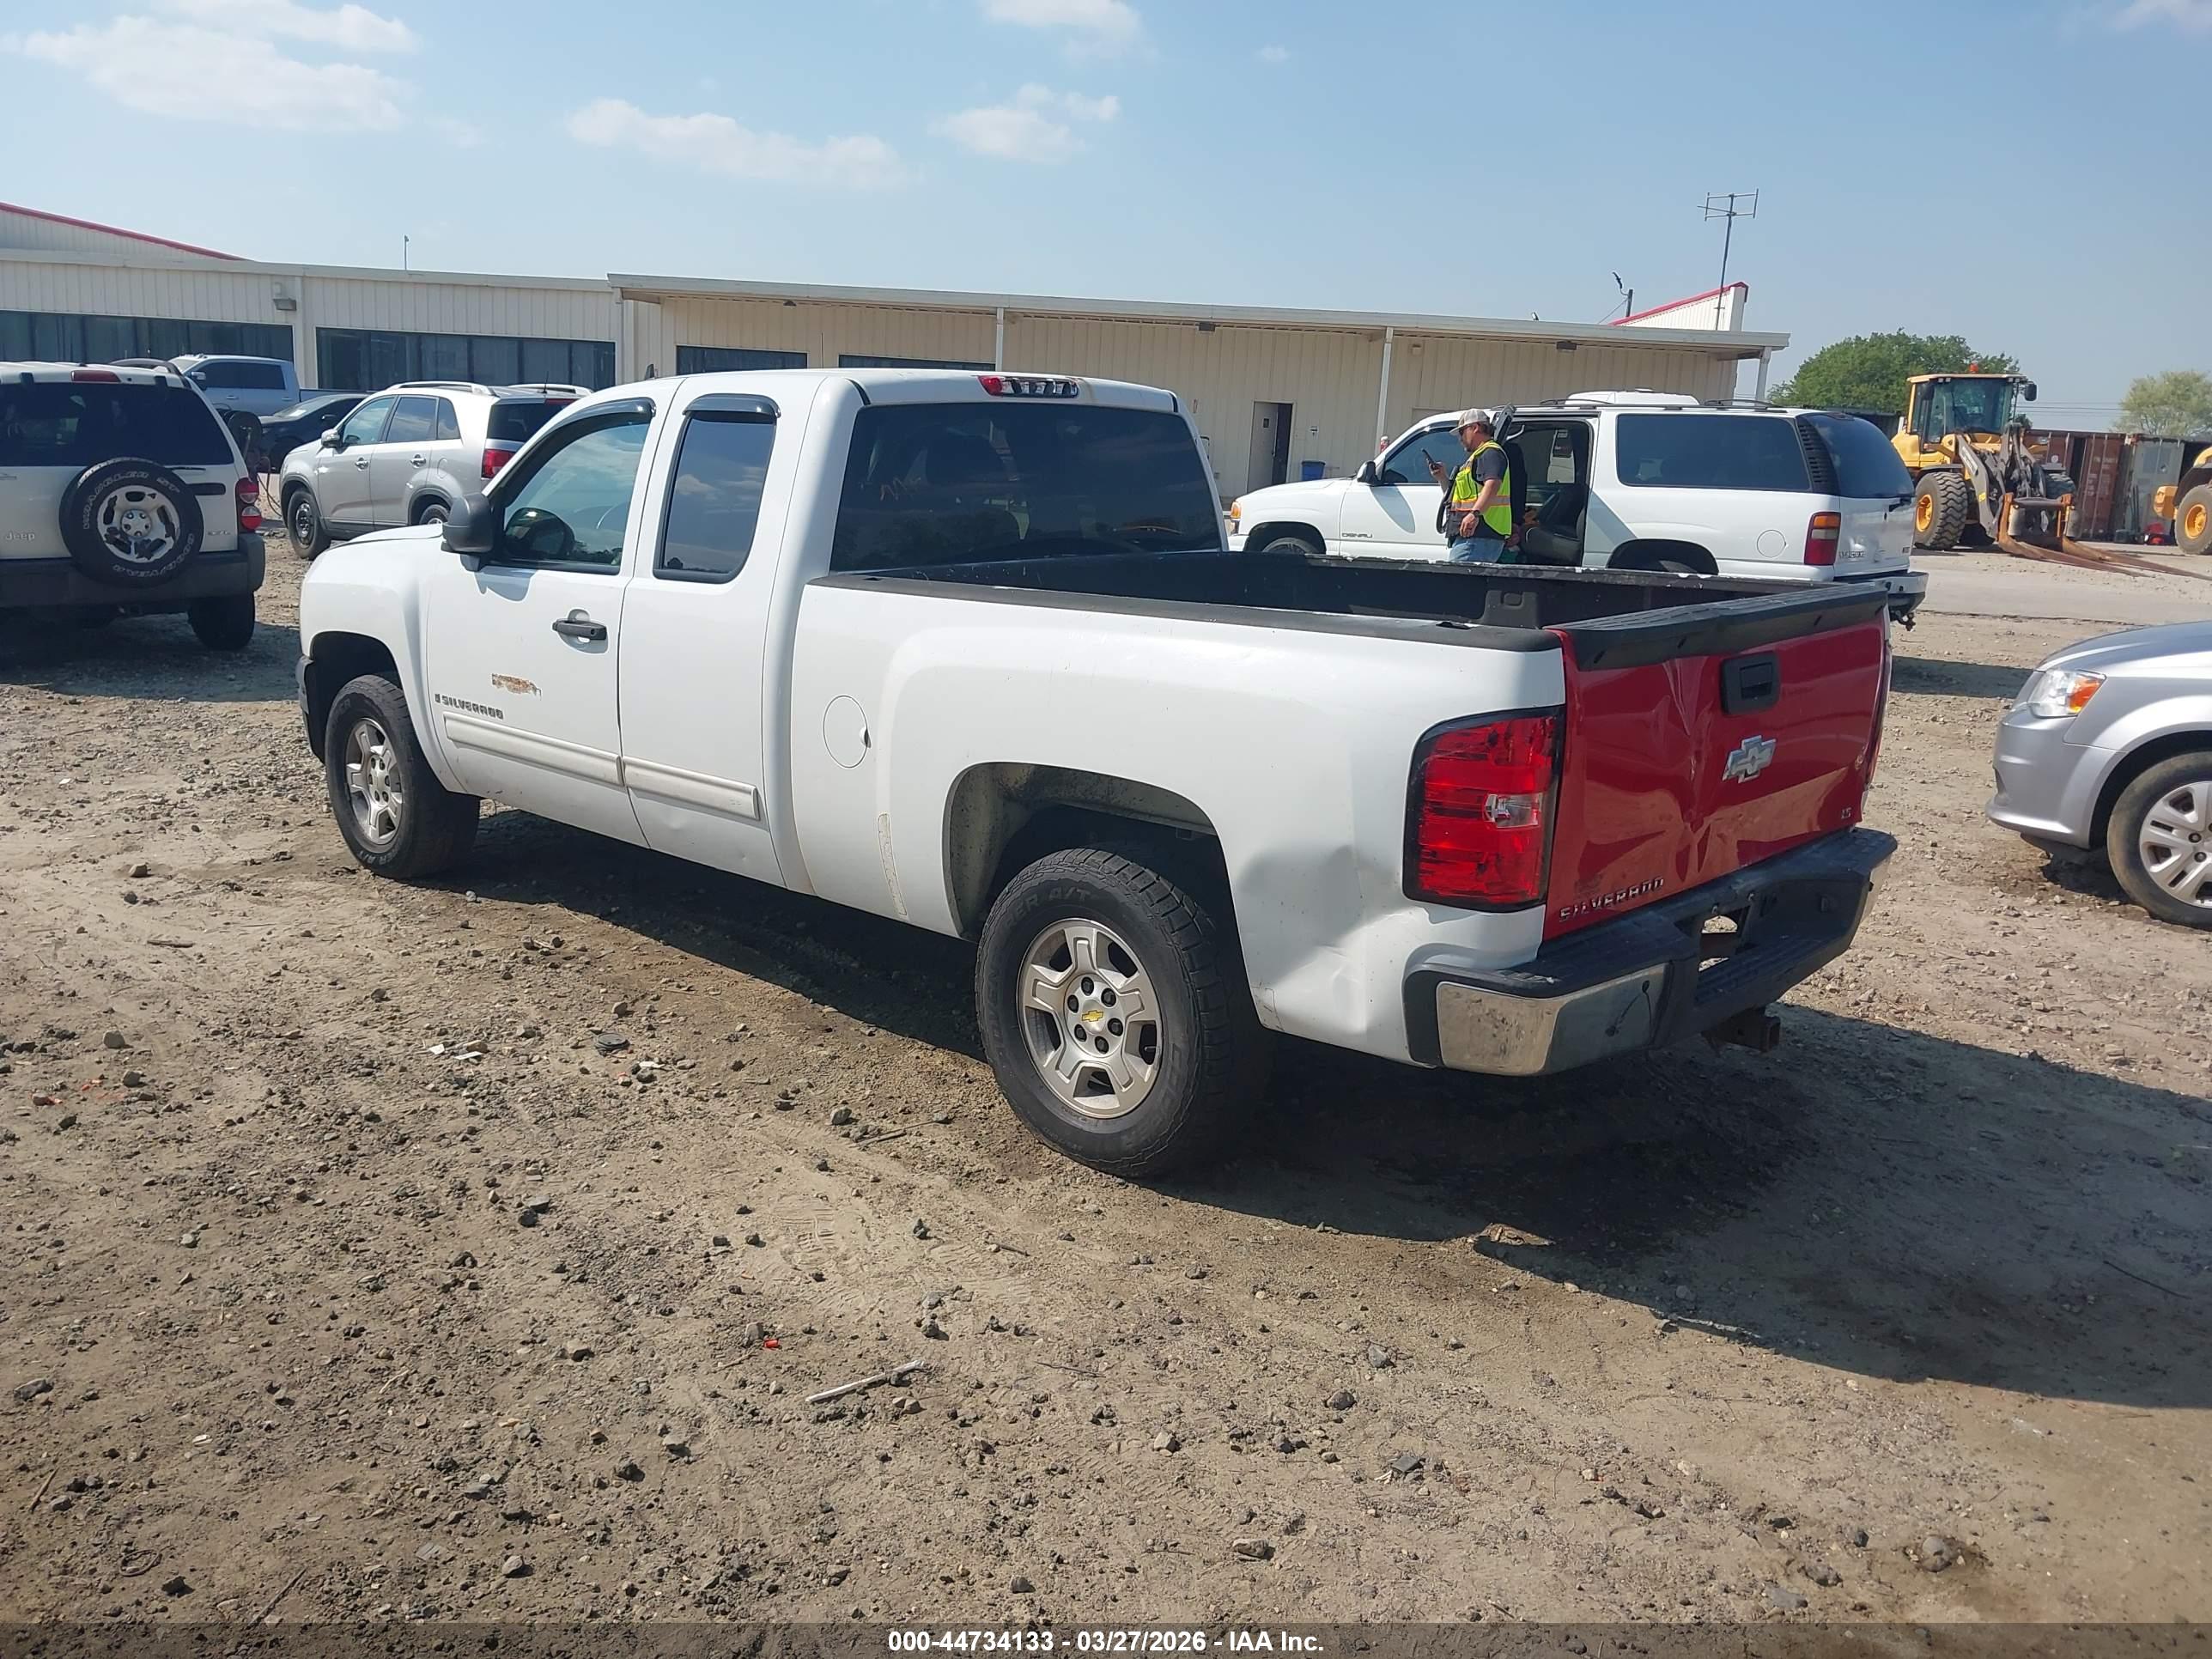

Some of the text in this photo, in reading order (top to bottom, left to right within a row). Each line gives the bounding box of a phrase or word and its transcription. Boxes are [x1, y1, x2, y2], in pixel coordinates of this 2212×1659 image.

[5, 531, 35, 542] Jeep
[441, 695, 504, 720] SILVERADO
[1559, 875, 1665, 923] SILVERADO
